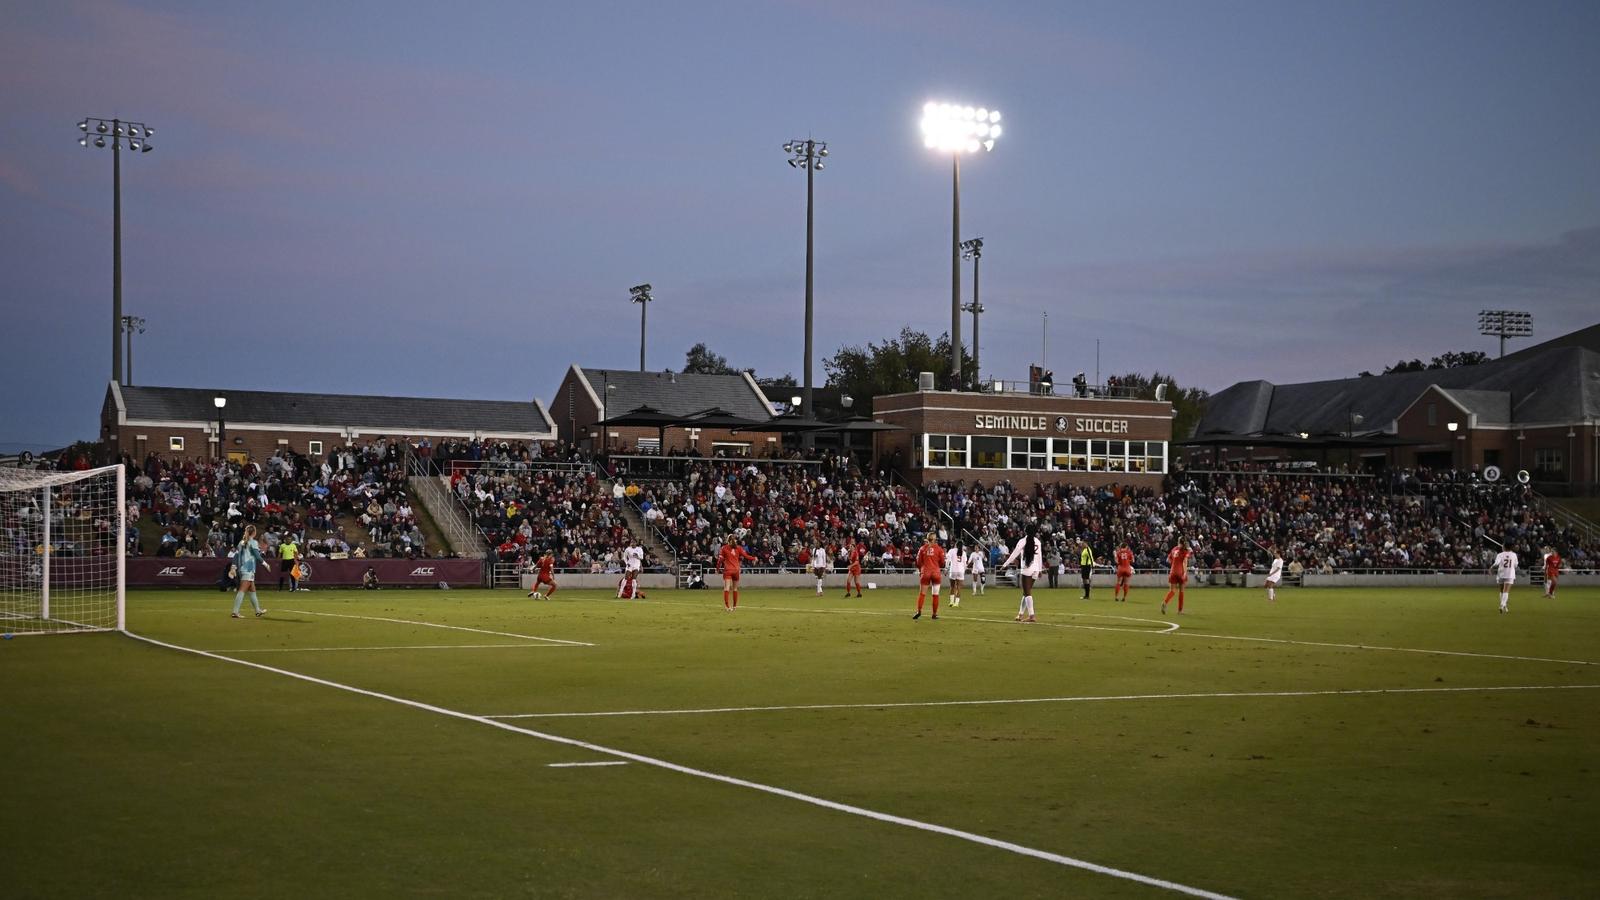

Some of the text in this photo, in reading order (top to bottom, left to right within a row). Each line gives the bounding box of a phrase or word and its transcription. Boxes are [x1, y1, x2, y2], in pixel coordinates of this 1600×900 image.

[975, 415, 1128, 433] SEMINOLE SOCCER
[1503, 559, 1512, 568] 21
[157, 566, 186, 576] ACC
[409, 567, 435, 576] ACC
